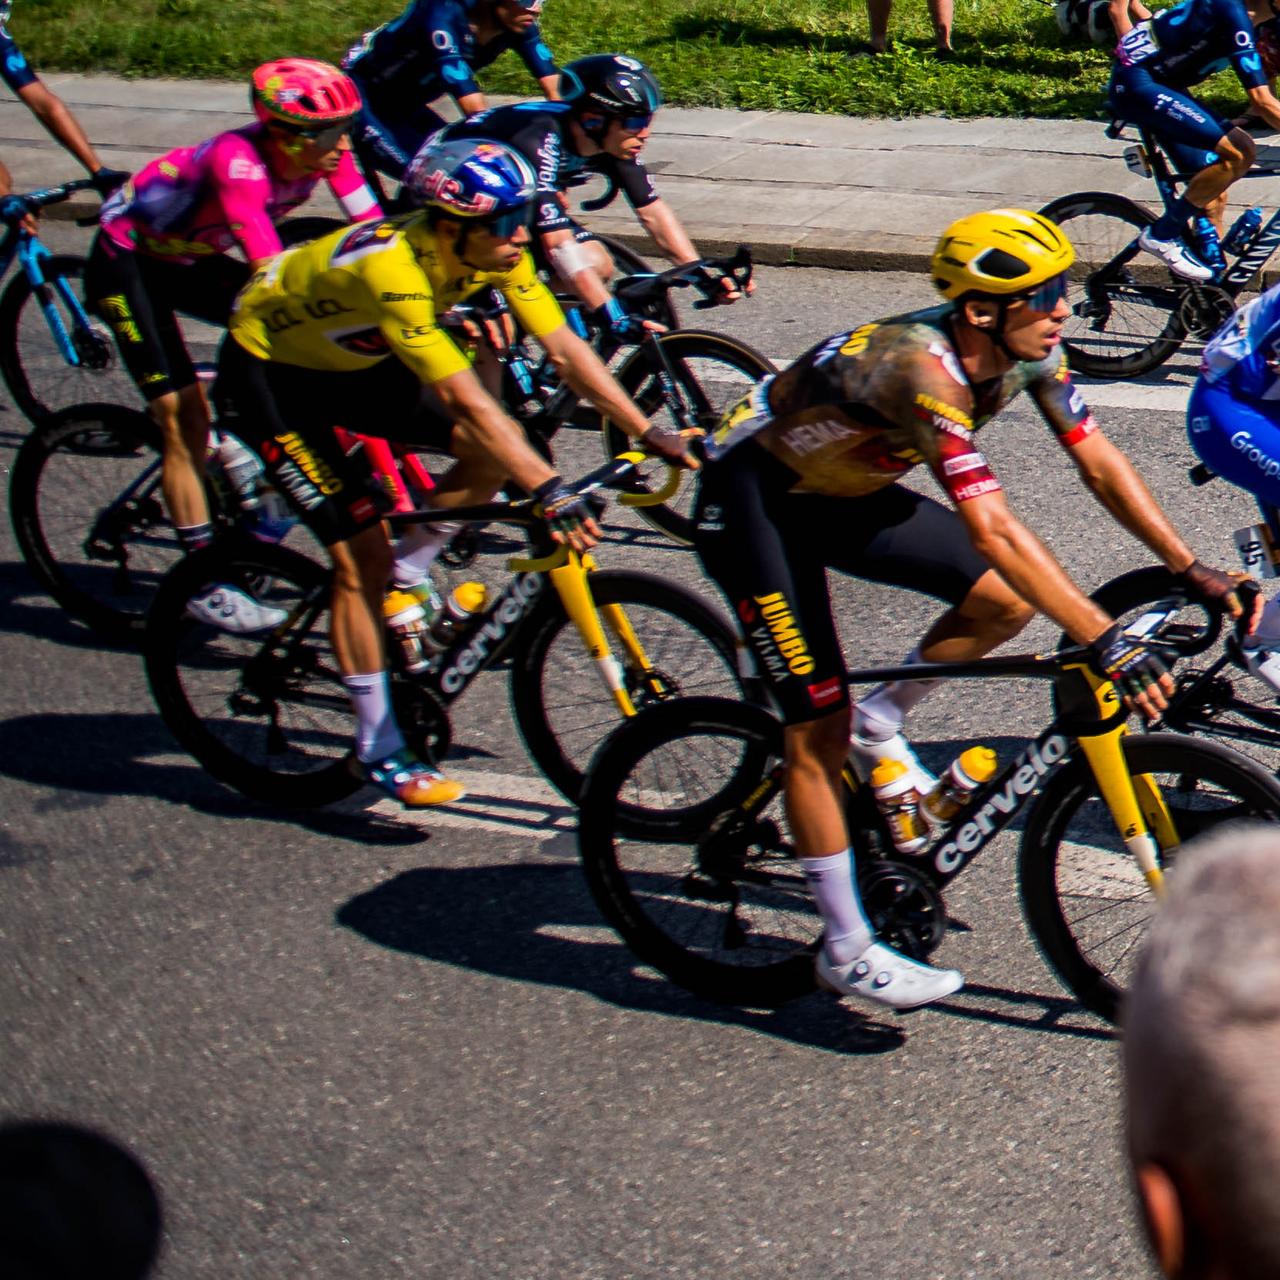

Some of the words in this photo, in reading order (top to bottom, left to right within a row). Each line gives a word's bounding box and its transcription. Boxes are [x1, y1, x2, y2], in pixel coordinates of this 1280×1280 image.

[780, 418, 862, 458] HEMA
[1239, 540, 1266, 567] 95
[749, 626, 792, 684] VISMA
[753, 591, 818, 678] JUMBO
